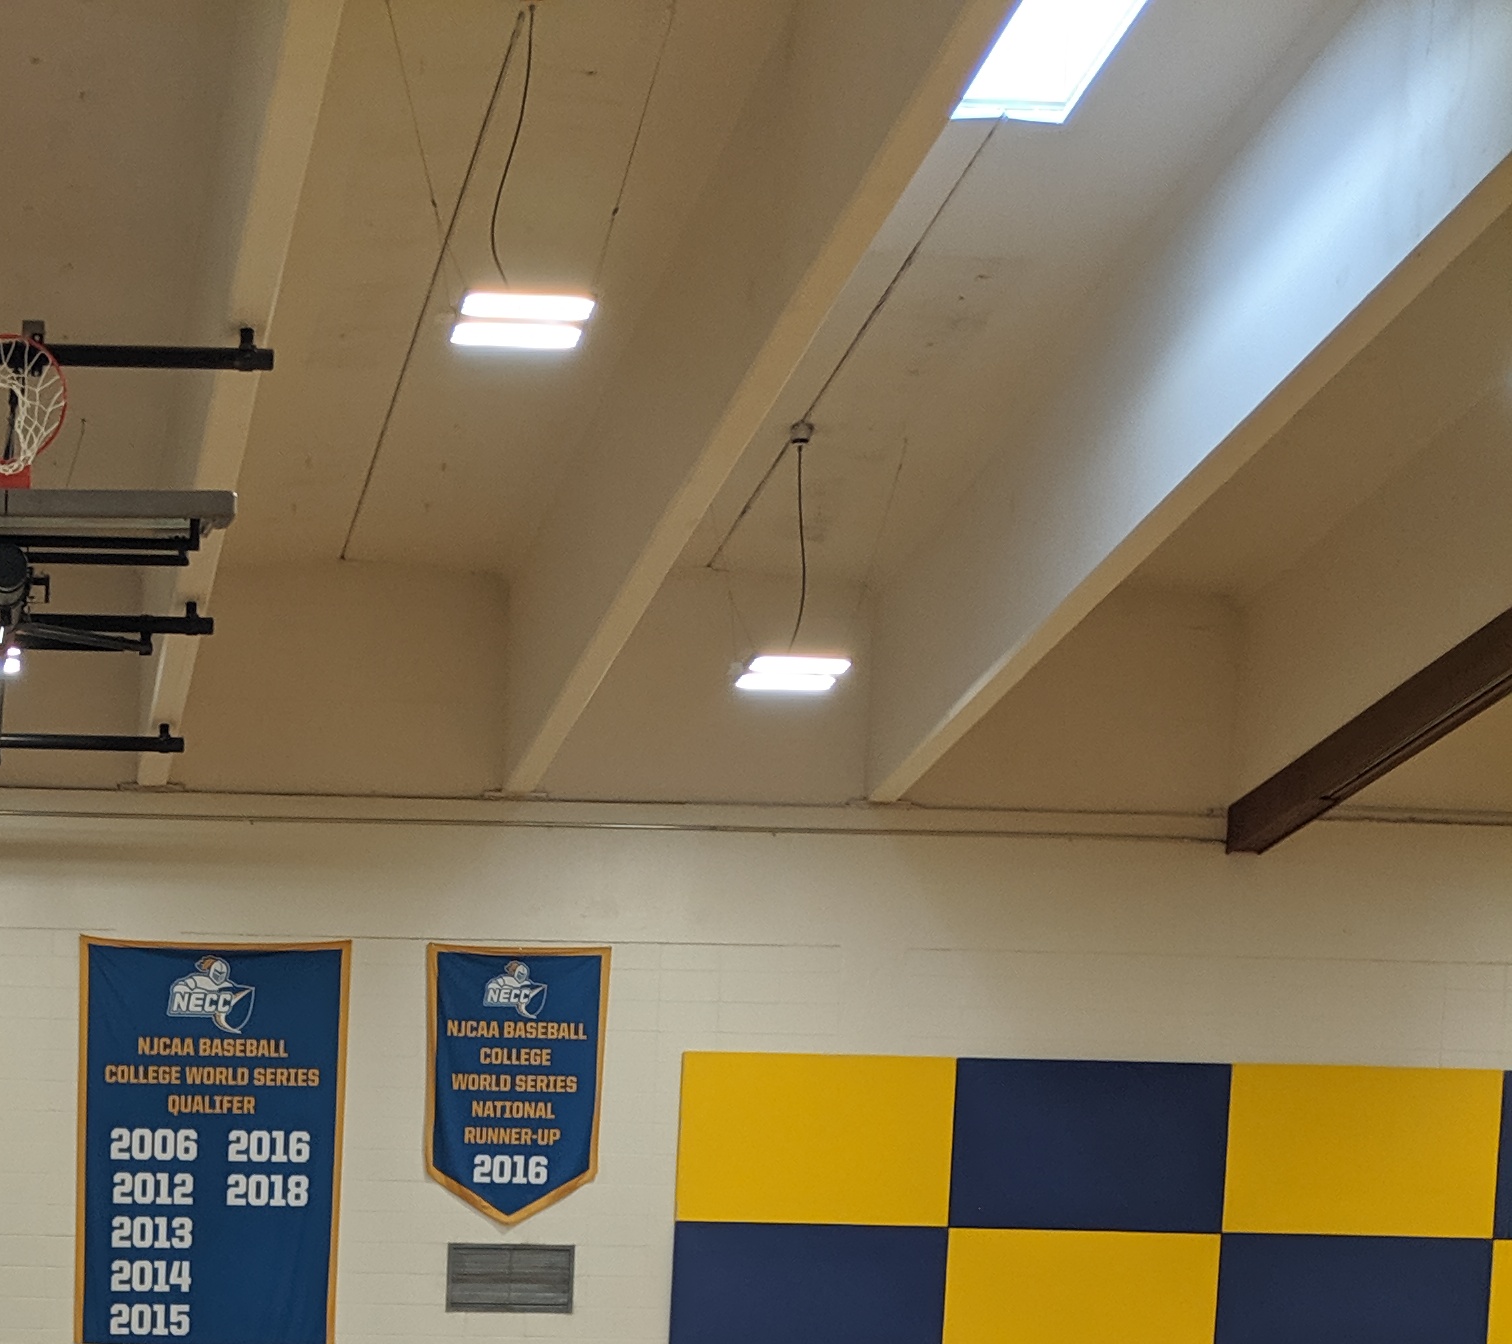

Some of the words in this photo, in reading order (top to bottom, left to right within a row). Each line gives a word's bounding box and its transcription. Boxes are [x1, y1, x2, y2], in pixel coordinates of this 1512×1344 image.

[172, 990, 232, 1013] NECC
[487, 988, 531, 1004] NECC
[447, 1020, 500, 1038] NJCAA
[503, 1021, 587, 1040] BASEBALL
[138, 1037, 195, 1056] NJCAA
[199, 1038, 288, 1058] BASEBALL
[480, 1047, 551, 1066] COLLEGE
[105, 1064, 181, 1085] COLLEGE
[186, 1066, 249, 1086] WORLD
[253, 1067, 320, 1087] SERIES
[452, 1073, 511, 1091] WORLD
[515, 1075, 577, 1093] SERIES
[471, 1101, 555, 1119] NATIONAL
[110, 1127, 198, 1161] 2006
[228, 1130, 311, 1163] 2016
[464, 1126, 561, 1146] RUNNER-UP
[473, 1154, 548, 1185] 2016
[112, 1172, 194, 1205] 2012
[226, 1174, 309, 1207] 2018
[111, 1216, 193, 1249] 2013
[110, 1260, 192, 1293] 2014
[109, 1303, 191, 1336] 2015
